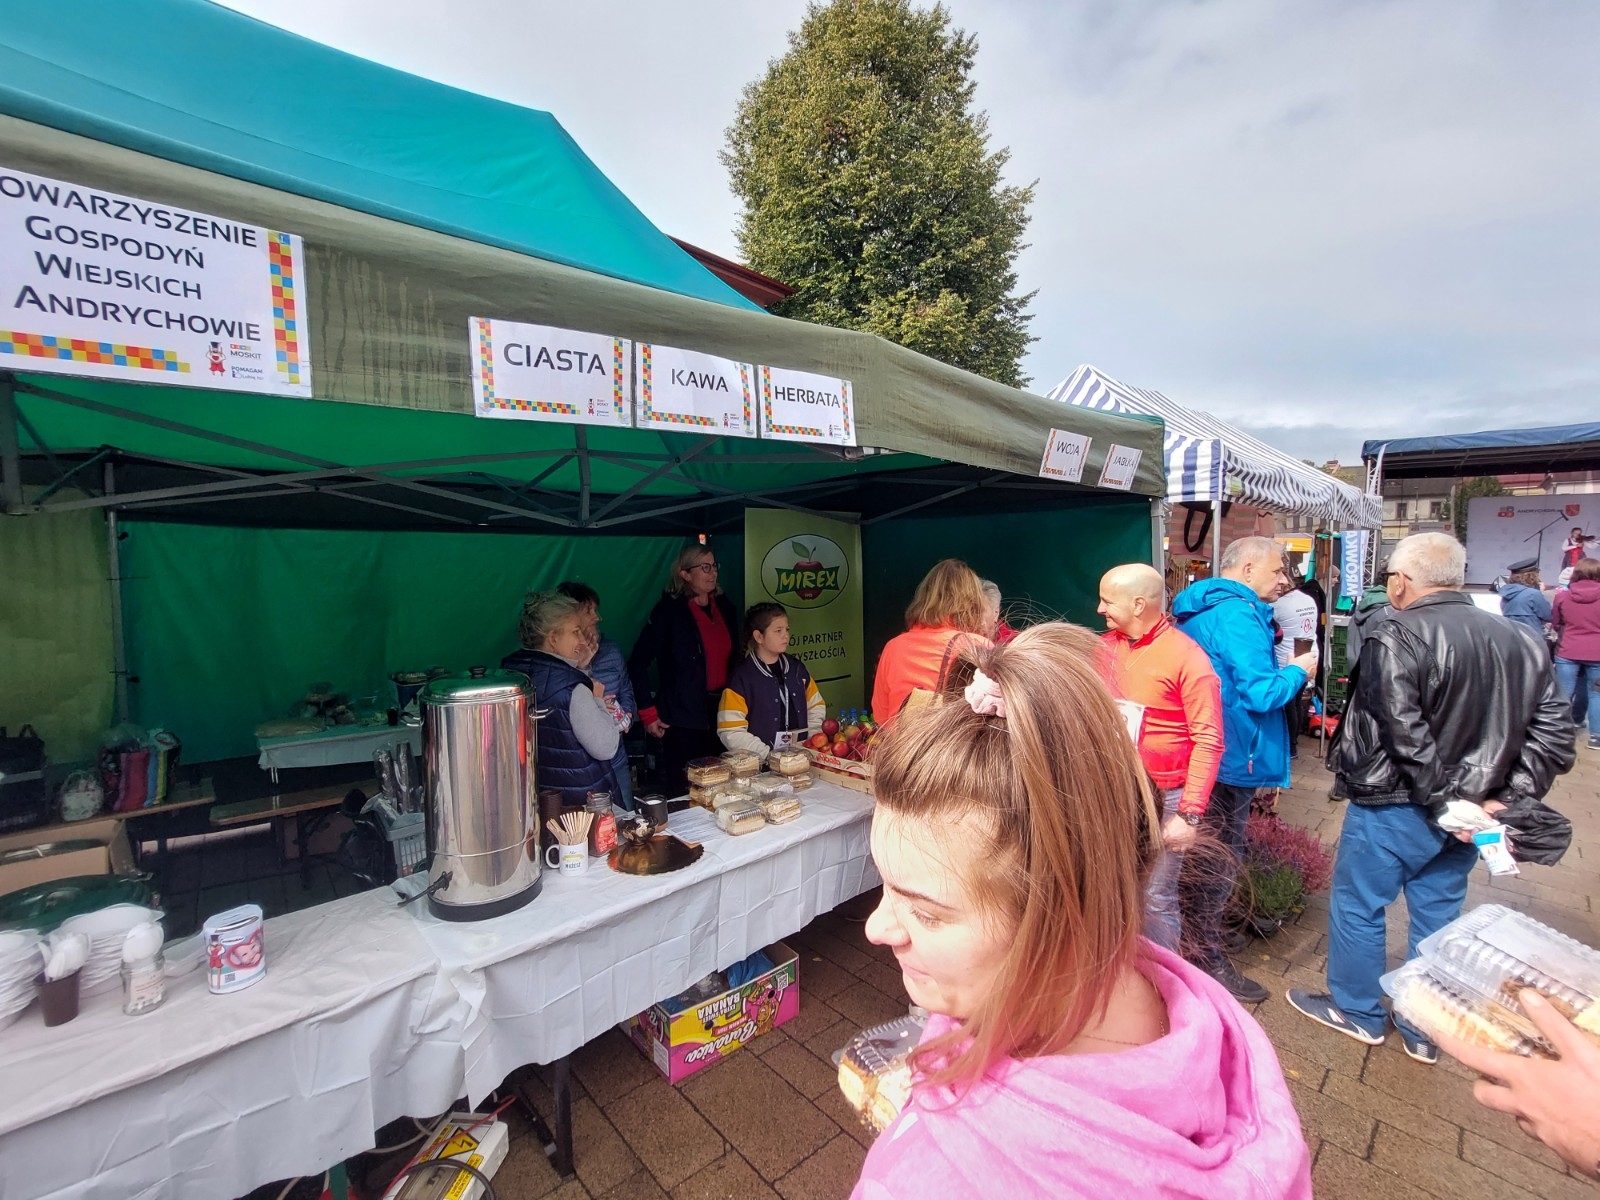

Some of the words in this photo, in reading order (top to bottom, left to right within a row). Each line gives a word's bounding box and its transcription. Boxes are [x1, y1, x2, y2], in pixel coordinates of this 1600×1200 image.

[0, 176, 257, 247] OWARZYSZENIE
[25, 215, 205, 269] GOSPODYŃ
[34, 251, 202, 300] WIEJSKICH
[14, 285, 261, 341] ANDRYCHOWIE
[230, 350, 262, 359] MOSKIT
[503, 342, 606, 376] CIASTA
[671, 367, 729, 393] KAWA
[774, 385, 841, 409] HERBATA
[780, 570, 836, 591] MIREX
[803, 631, 844, 645] PARTNER
[697, 992, 740, 1019] BANANA
[684, 1020, 757, 1063] Banarica
